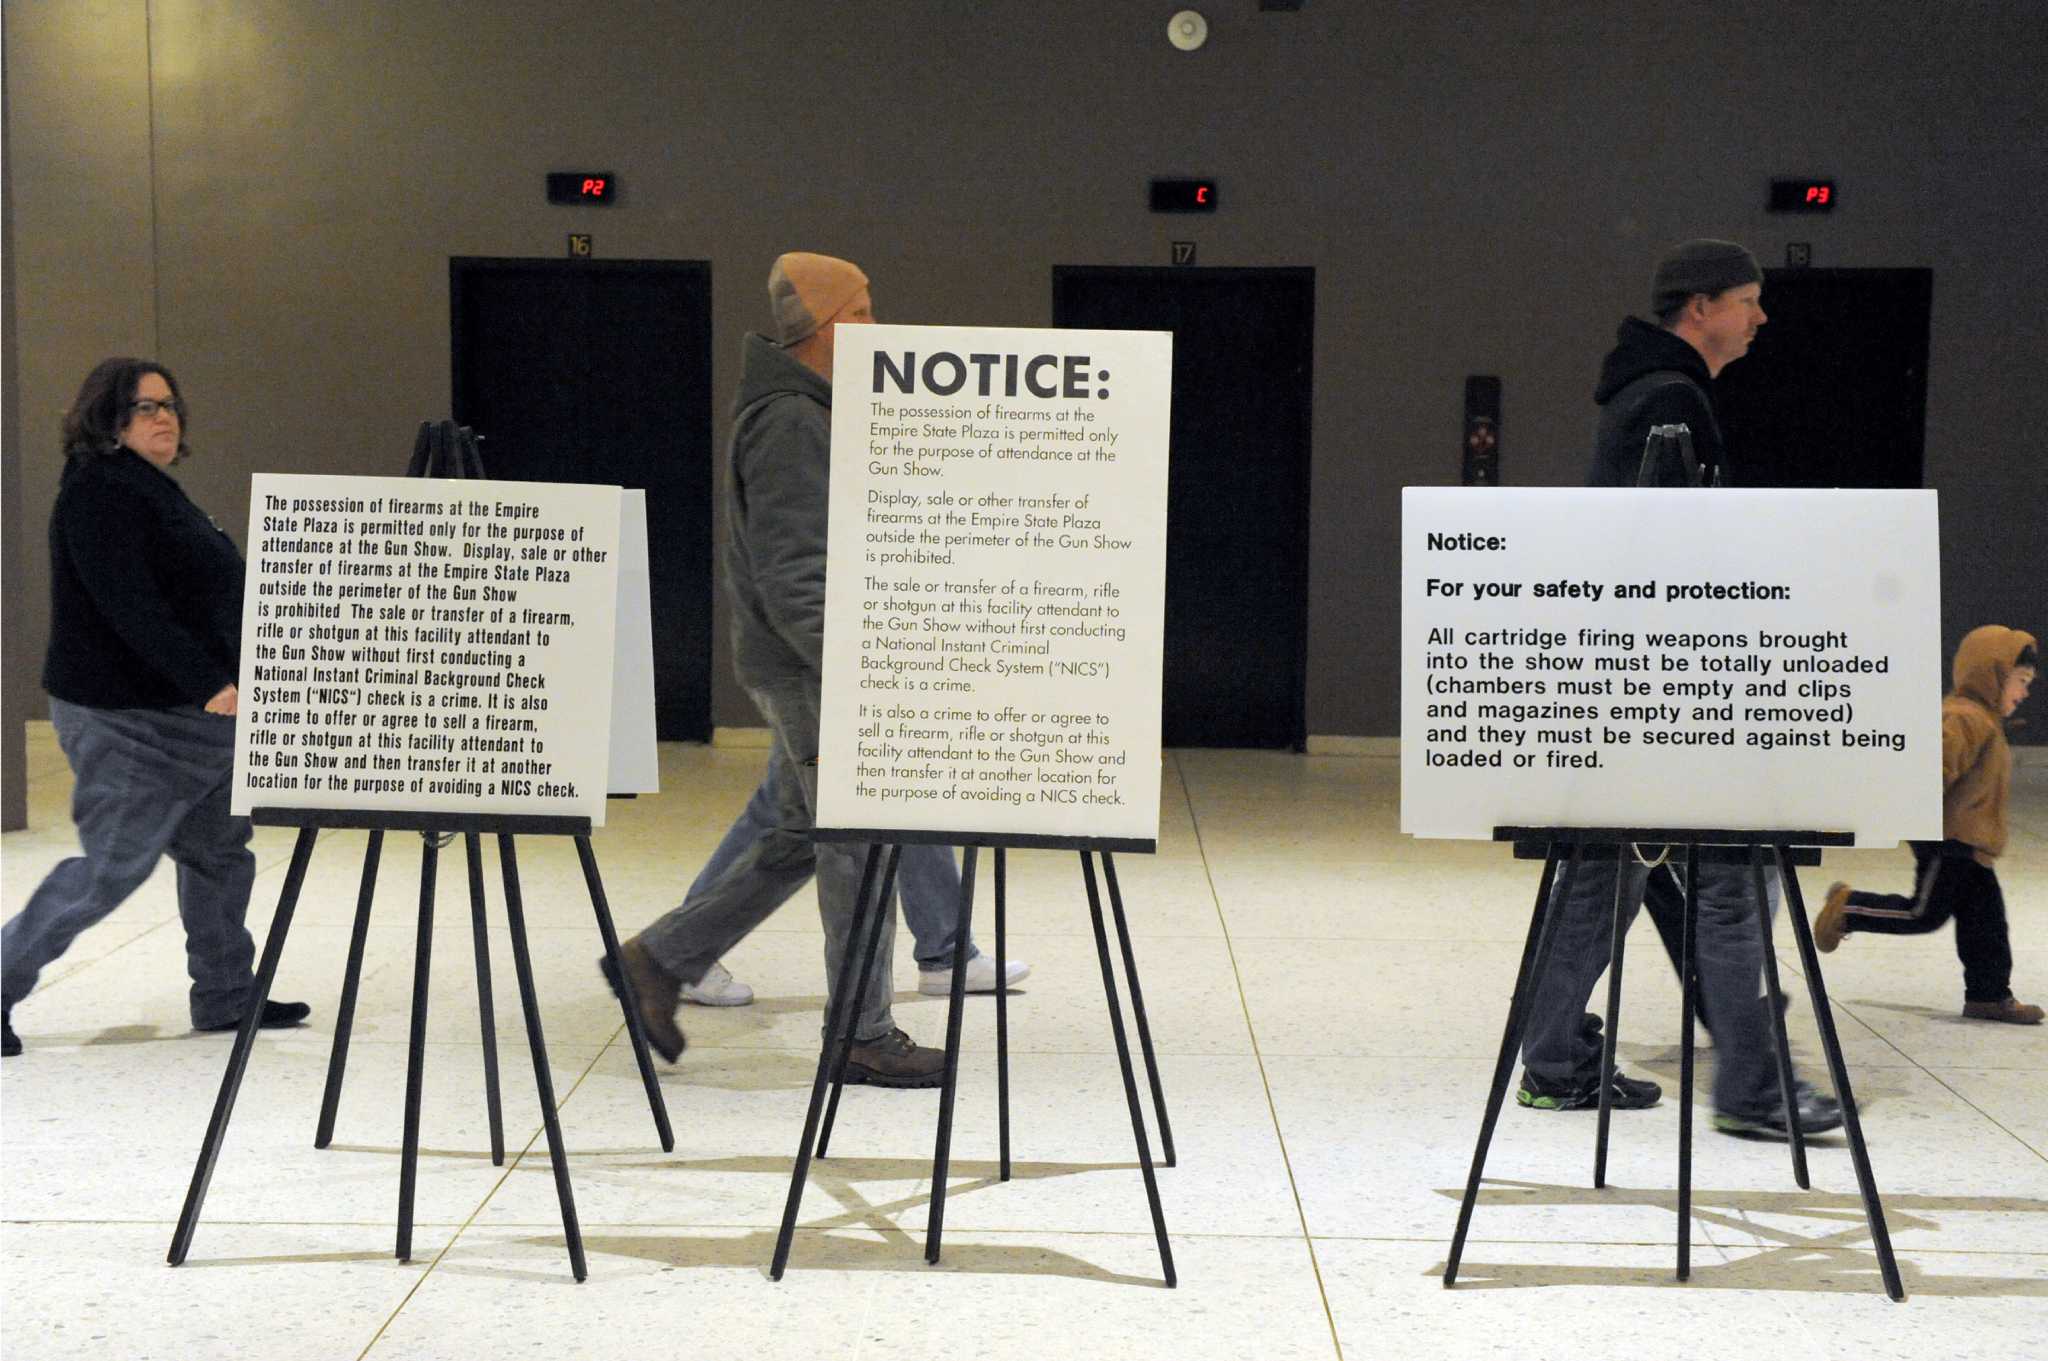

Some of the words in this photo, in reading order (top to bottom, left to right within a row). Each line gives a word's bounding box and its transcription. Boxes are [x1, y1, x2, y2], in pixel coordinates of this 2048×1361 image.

[582, 179, 605, 196] P2
[1196, 187, 1208, 203] C
[1806, 186, 1830, 204] P3
[571, 236, 590, 256] 16
[1174, 243, 1194, 264] 17
[872, 350, 1110, 400] NOTICE:
[870, 401, 895, 417] The
[898, 404, 972, 422] possession
[975, 403, 992, 420] of
[994, 403, 1052, 421] firearms
[1055, 409, 1070, 422] at
[1073, 406, 1095, 422] the
[869, 421, 918, 441] Empire
[922, 423, 957, 438] State
[961, 422, 1000, 439] Plaza
[1004, 425, 1015, 440] is
[1018, 425, 1085, 444] permitted
[1088, 426, 1118, 447] only
[264, 494, 288, 512] The
[291, 496, 365, 514] possession
[368, 497, 383, 514] of
[387, 497, 444, 516] firearms
[448, 499, 463, 516] at
[468, 500, 490, 518] the
[494, 500, 540, 521] Empire
[867, 488, 922, 509] Display,
[926, 489, 954, 506] sale
[957, 496, 974, 506] or
[977, 491, 1014, 507] other
[1017, 492, 1071, 509] transfer
[1074, 493, 1089, 510] of
[260, 535, 334, 555] attendance
[338, 538, 353, 555] at
[357, 538, 379, 556] the
[383, 538, 408, 557] Gun
[412, 539, 452, 558] Show.
[462, 541, 515, 562] Display,
[520, 544, 548, 561] sale
[552, 548, 567, 562] or
[571, 545, 608, 563] other
[865, 527, 916, 544] outside
[919, 528, 941, 545] the
[944, 531, 1011, 549] perimeter
[1014, 530, 1030, 547] of
[1032, 531, 1055, 548] the
[1058, 533, 1089, 549] Gun
[1093, 533, 1132, 549] Show
[1426, 531, 1507, 552] Notice:
[260, 557, 314, 575] transfer
[318, 558, 333, 576] of
[337, 559, 393, 578] firearms
[397, 561, 412, 578] at
[416, 561, 439, 579] the
[443, 562, 489, 582] Empire
[493, 563, 530, 582] State
[534, 565, 571, 584] Plaza
[863, 575, 889, 591] The
[893, 575, 921, 593] sale
[924, 582, 940, 593] or
[943, 578, 997, 595] transfer
[1000, 578, 1016, 595] of
[1018, 585, 1029, 596] a
[1033, 579, 1088, 599] firearm,
[1093, 581, 1120, 598] rifle
[1425, 577, 1465, 598] For
[1472, 581, 1523, 601] your
[1532, 578, 1605, 603] safety
[1613, 579, 1657, 600] and
[1665, 580, 1791, 603] protection:
[257, 599, 270, 617] is
[274, 600, 341, 620] prohibited
[350, 602, 374, 620] The
[378, 603, 406, 621] sale
[410, 607, 426, 621] or
[430, 604, 485, 623] transfer
[489, 606, 504, 624] of
[508, 610, 517, 624] a
[521, 607, 575, 627] firearm,
[861, 639, 871, 650] a
[875, 635, 936, 652] National
[940, 637, 986, 653] Instant
[990, 638, 1050, 655] Criminal
[1426, 626, 1454, 646] All
[1463, 627, 1567, 651] cartridge
[1577, 627, 1635, 652] firing
[1644, 632, 1749, 652] weapons
[1758, 629, 1849, 653] brought
[1426, 650, 1468, 670] into
[1477, 650, 1515, 671] the
[1524, 651, 1585, 671] show
[1594, 653, 1651, 672] must
[1660, 652, 1690, 672] be
[1699, 653, 1772, 677] totally
[1782, 654, 1889, 674] unloaded
[253, 664, 308, 682] National
[312, 665, 360, 684] Instant
[364, 666, 419, 686] Criminal
[423, 668, 501, 690] Background
[505, 671, 545, 690] Check
[859, 673, 900, 690] check
[904, 676, 915, 690] is
[918, 680, 929, 691] a
[932, 677, 977, 692] crime.
[1426, 672, 1547, 696] (chambers
[1556, 677, 1613, 696] must
[1623, 676, 1652, 696] be
[1661, 678, 1734, 701] empty
[1744, 678, 1787, 698] and
[1797, 678, 1852, 702] clips
[250, 710, 259, 724] a
[263, 707, 301, 725] crime
[305, 708, 319, 726] to
[323, 708, 358, 727] offer
[361, 713, 377, 727] or
[380, 713, 419, 731] agree
[423, 711, 438, 729] to
[442, 712, 467, 730] sell
[471, 716, 480, 730] a
[484, 713, 538, 733] firearm,
[1425, 699, 1467, 719] and
[1477, 700, 1599, 723] magazines
[1609, 702, 1681, 725] empty
[1691, 702, 1734, 722] and
[1744, 701, 1854, 725] removed)
[857, 721, 880, 738] sell
[884, 727, 894, 738] a
[898, 722, 953, 742] firearm,
[958, 724, 986, 741] rifle
[989, 731, 1005, 742] or
[1008, 726, 1064, 748] shotgun
[1067, 731, 1083, 744] at
[1086, 728, 1110, 745] this
[1425, 723, 1467, 743] and
[1476, 724, 1527, 747] they
[1536, 725, 1593, 744] must
[1602, 725, 1632, 745] be
[1641, 727, 1735, 746] secured
[1745, 727, 1831, 751] against
[1841, 728, 1906, 752] being
[1425, 747, 1502, 768] loaded
[1512, 753, 1537, 768] or
[1545, 749, 1604, 769] fired.
[855, 780, 877, 797] the
[880, 787, 938, 802] purpose
[941, 783, 957, 800] of
[960, 785, 1022, 806] avoiding
[1025, 792, 1035, 802] a
[1040, 788, 1077, 804] NICS
[1081, 788, 1127, 805] check.
